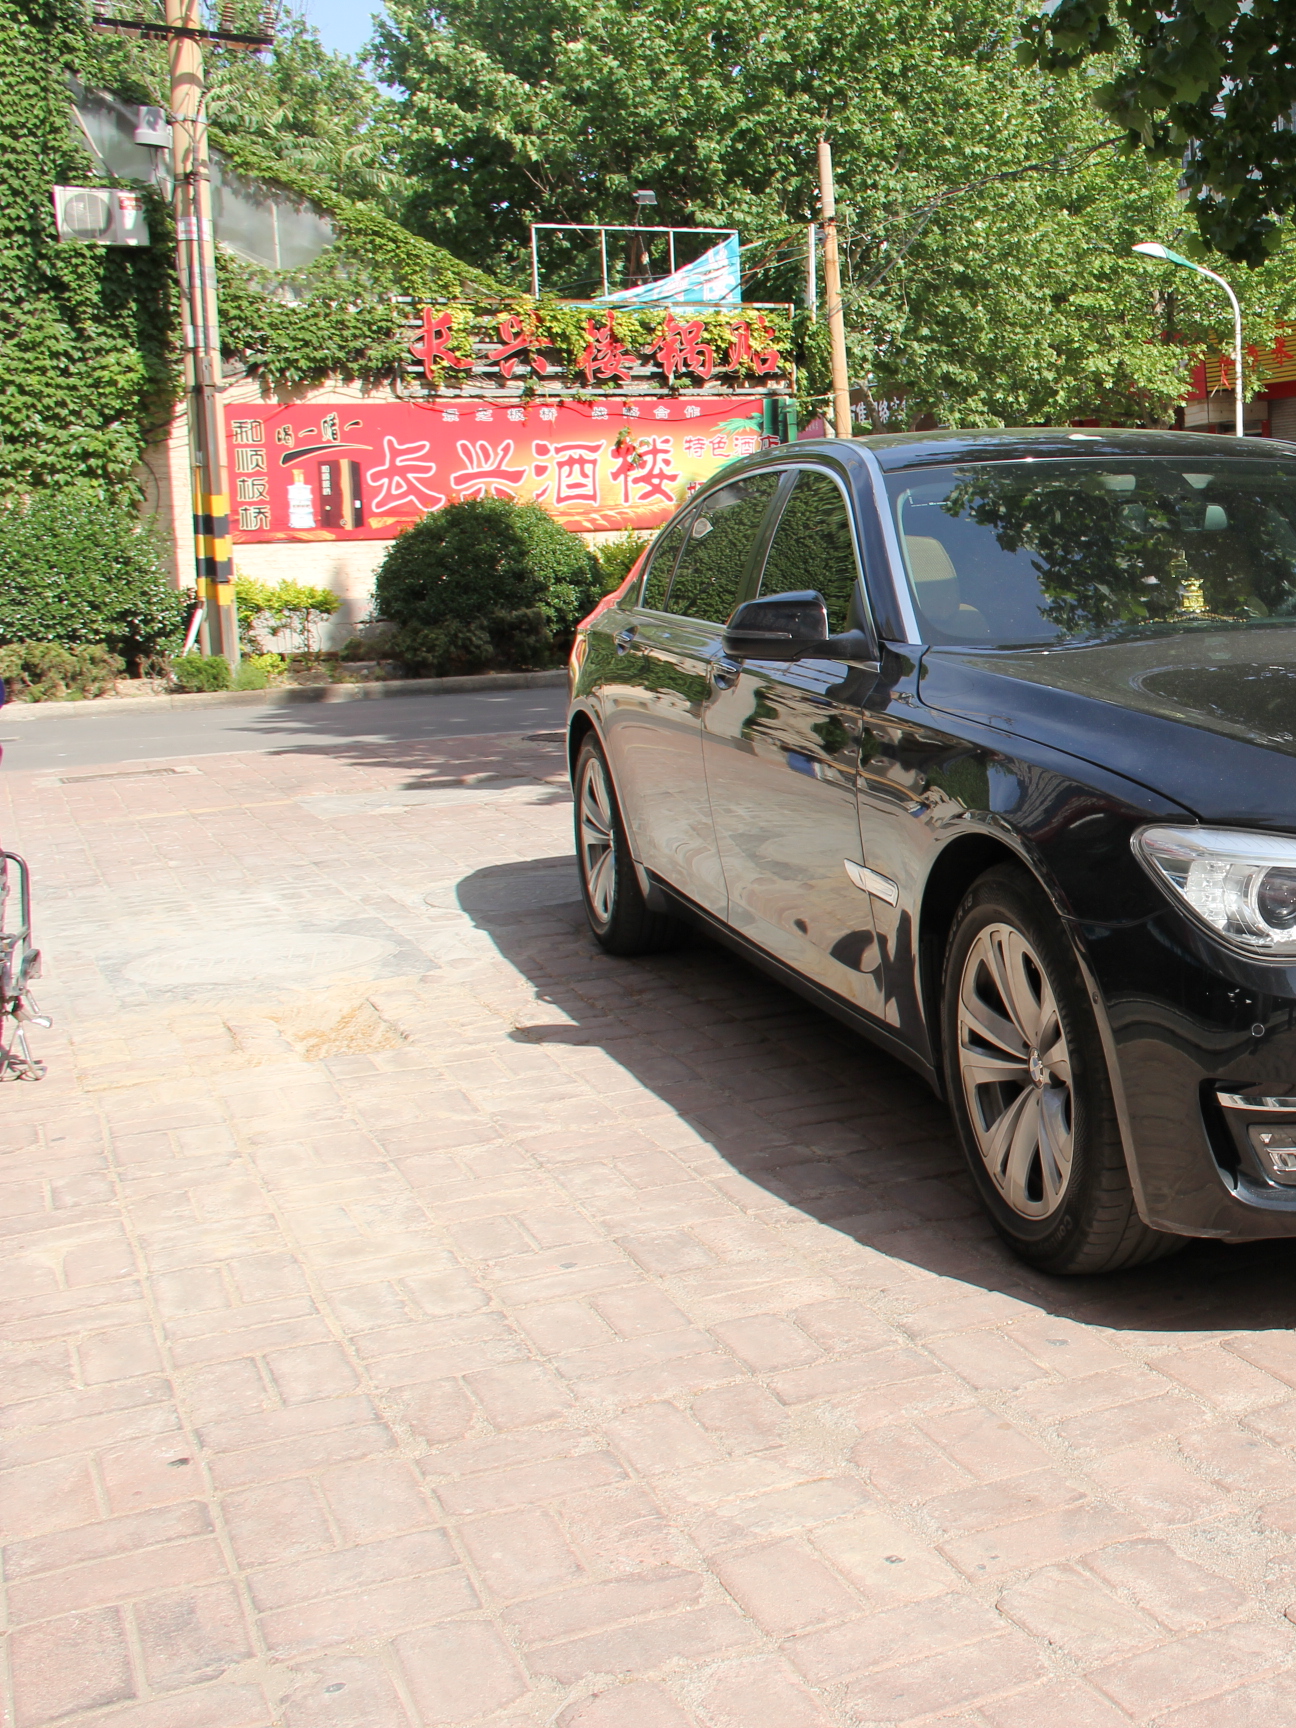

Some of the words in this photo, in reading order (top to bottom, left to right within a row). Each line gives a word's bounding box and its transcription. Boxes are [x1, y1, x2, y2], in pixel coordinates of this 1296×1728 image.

[409, 307, 780, 382] 长兴楼锅贴
[231, 419, 272, 531] 和顺板桥
[366, 435, 683, 513] 长兴酒楼
